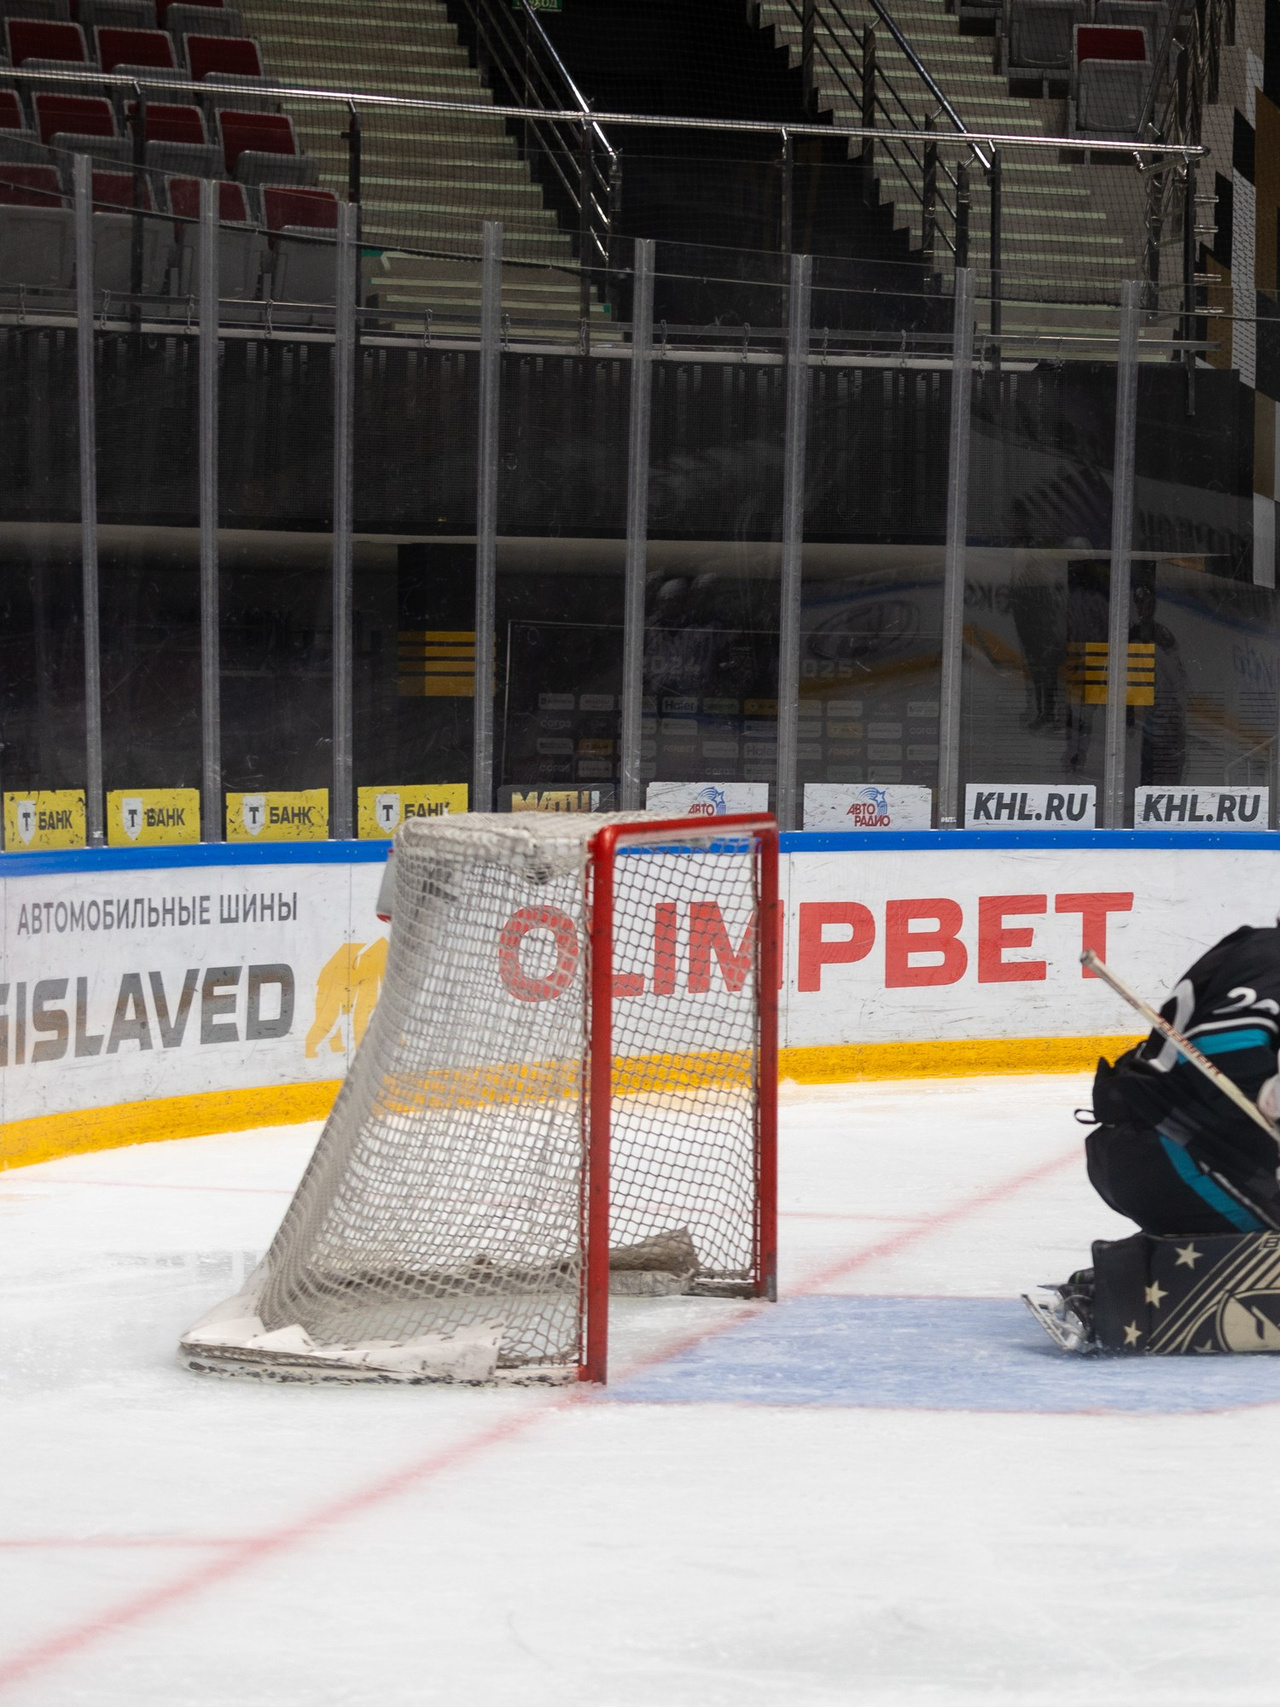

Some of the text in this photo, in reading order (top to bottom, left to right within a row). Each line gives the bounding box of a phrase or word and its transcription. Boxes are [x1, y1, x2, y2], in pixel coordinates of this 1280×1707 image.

[146, 807, 186, 827] БАНК
[269, 806, 312, 824] БАНК
[846, 802, 877, 816] АВТО
[973, 791, 1089, 822] KHL.RU
[1142, 793, 1261, 823] KHL.RU
[38, 809, 73, 831] БАНК
[853, 813, 891, 828] РАДИО
[17, 892, 298, 936] АВТОМОБИЛЬНЫЕ ШИНЫ
[0, 962, 295, 1068] ISLAVED
